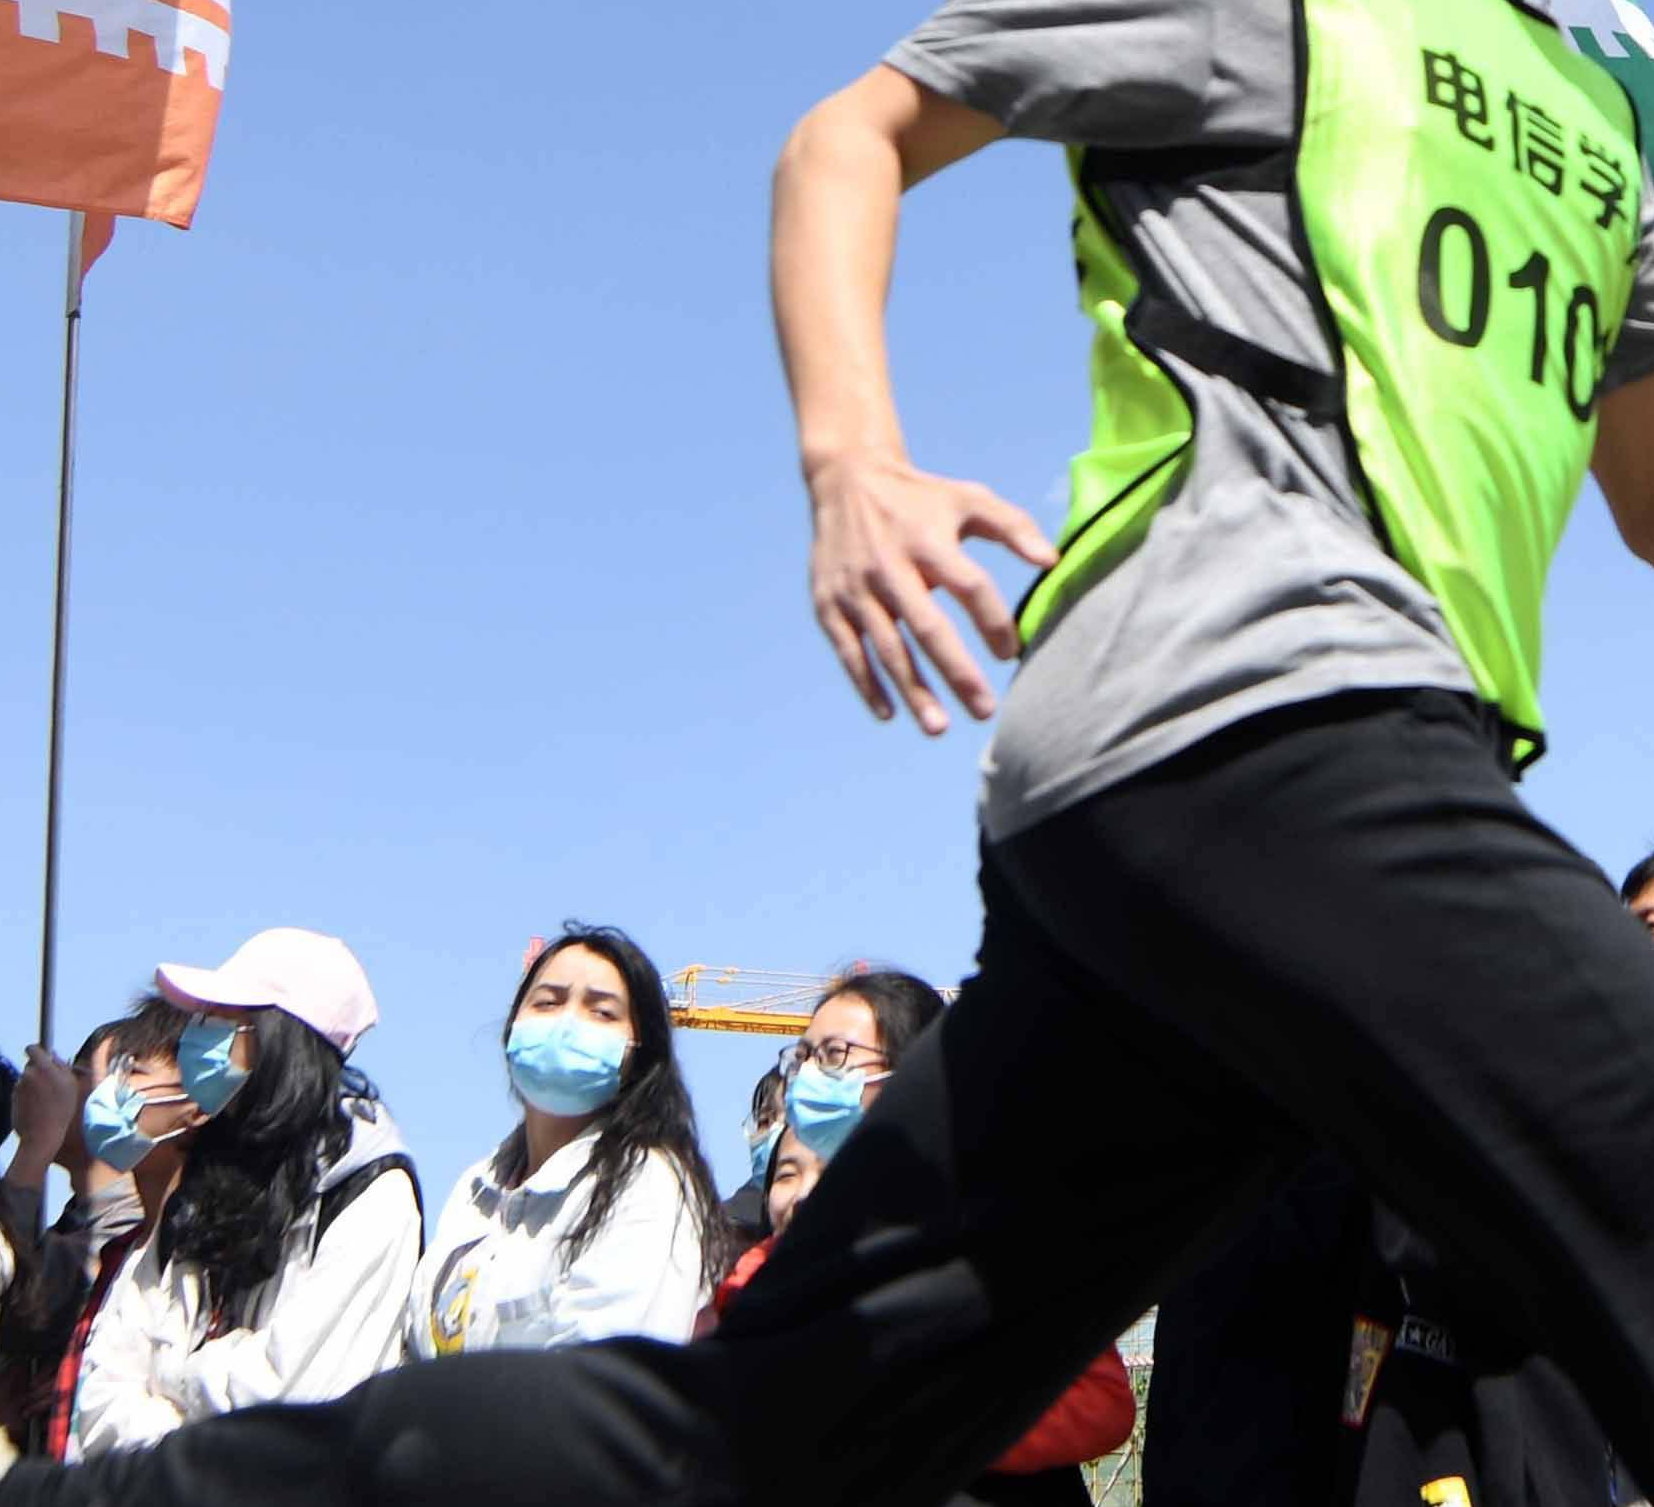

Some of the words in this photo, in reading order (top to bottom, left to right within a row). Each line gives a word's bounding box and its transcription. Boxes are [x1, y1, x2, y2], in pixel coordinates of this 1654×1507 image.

[1421, 47, 1634, 239] 电信学
[1417, 205, 1606, 425] 010
